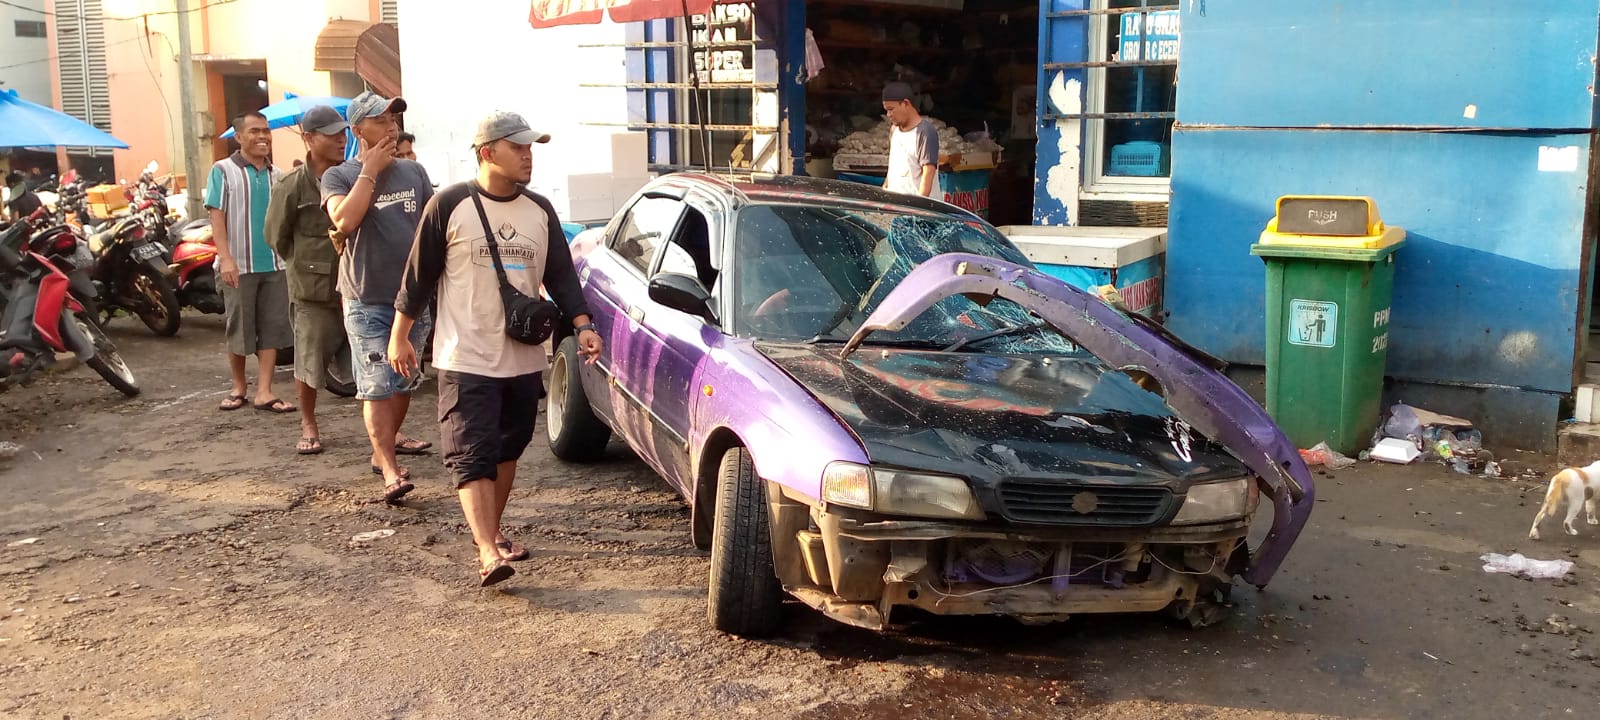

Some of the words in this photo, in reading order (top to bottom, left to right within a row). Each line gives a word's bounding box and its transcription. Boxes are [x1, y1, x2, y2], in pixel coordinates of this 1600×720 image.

[692, 27, 737, 47] IKAN
[693, 51, 744, 70] SUPER
[1123, 41, 1151, 61] GROR
[403, 200, 417, 212] 96
[1308, 209, 1337, 220] PUSH
